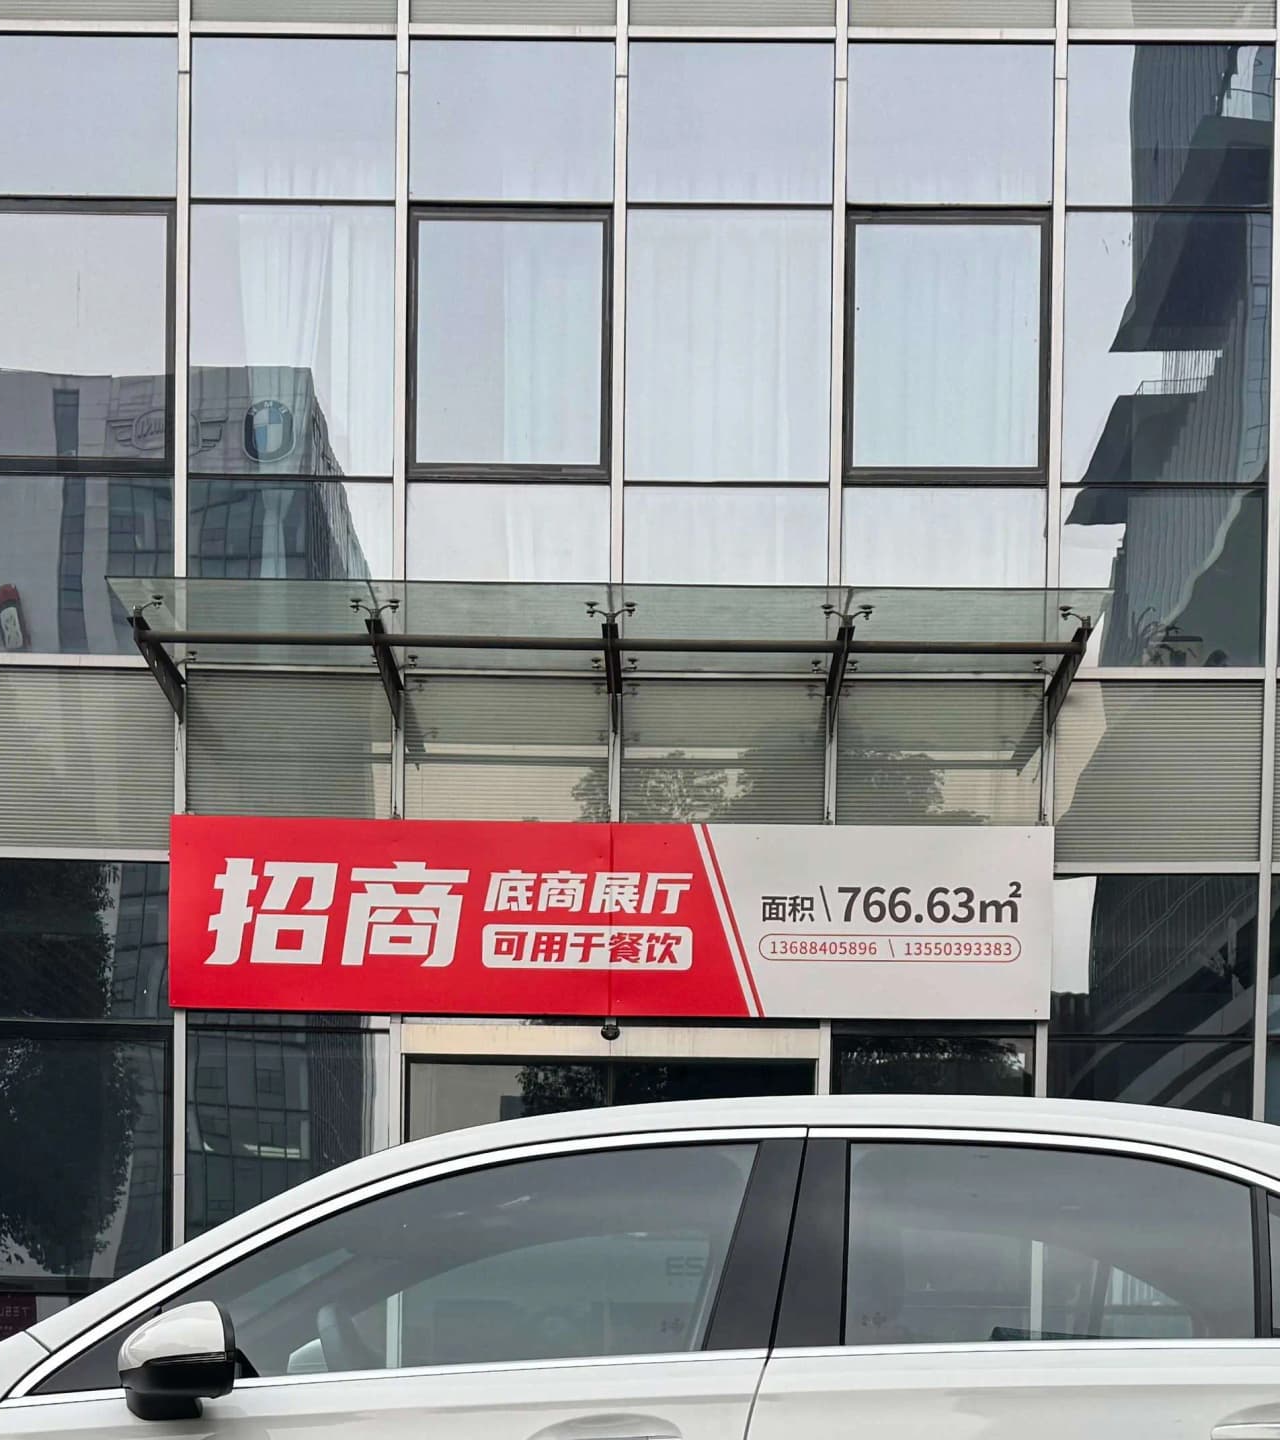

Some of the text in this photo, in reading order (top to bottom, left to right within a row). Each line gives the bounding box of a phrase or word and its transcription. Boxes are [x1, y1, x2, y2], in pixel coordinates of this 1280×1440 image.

[483, 869, 694, 914] 底商展厅
[203, 857, 470, 967] 招商
[761, 895, 815, 922] 面积
[494, 931, 682, 964] 可用于餐饮
[770, 940, 877, 956] 13688405896
[903, 942, 1012, 956] 13550393383
